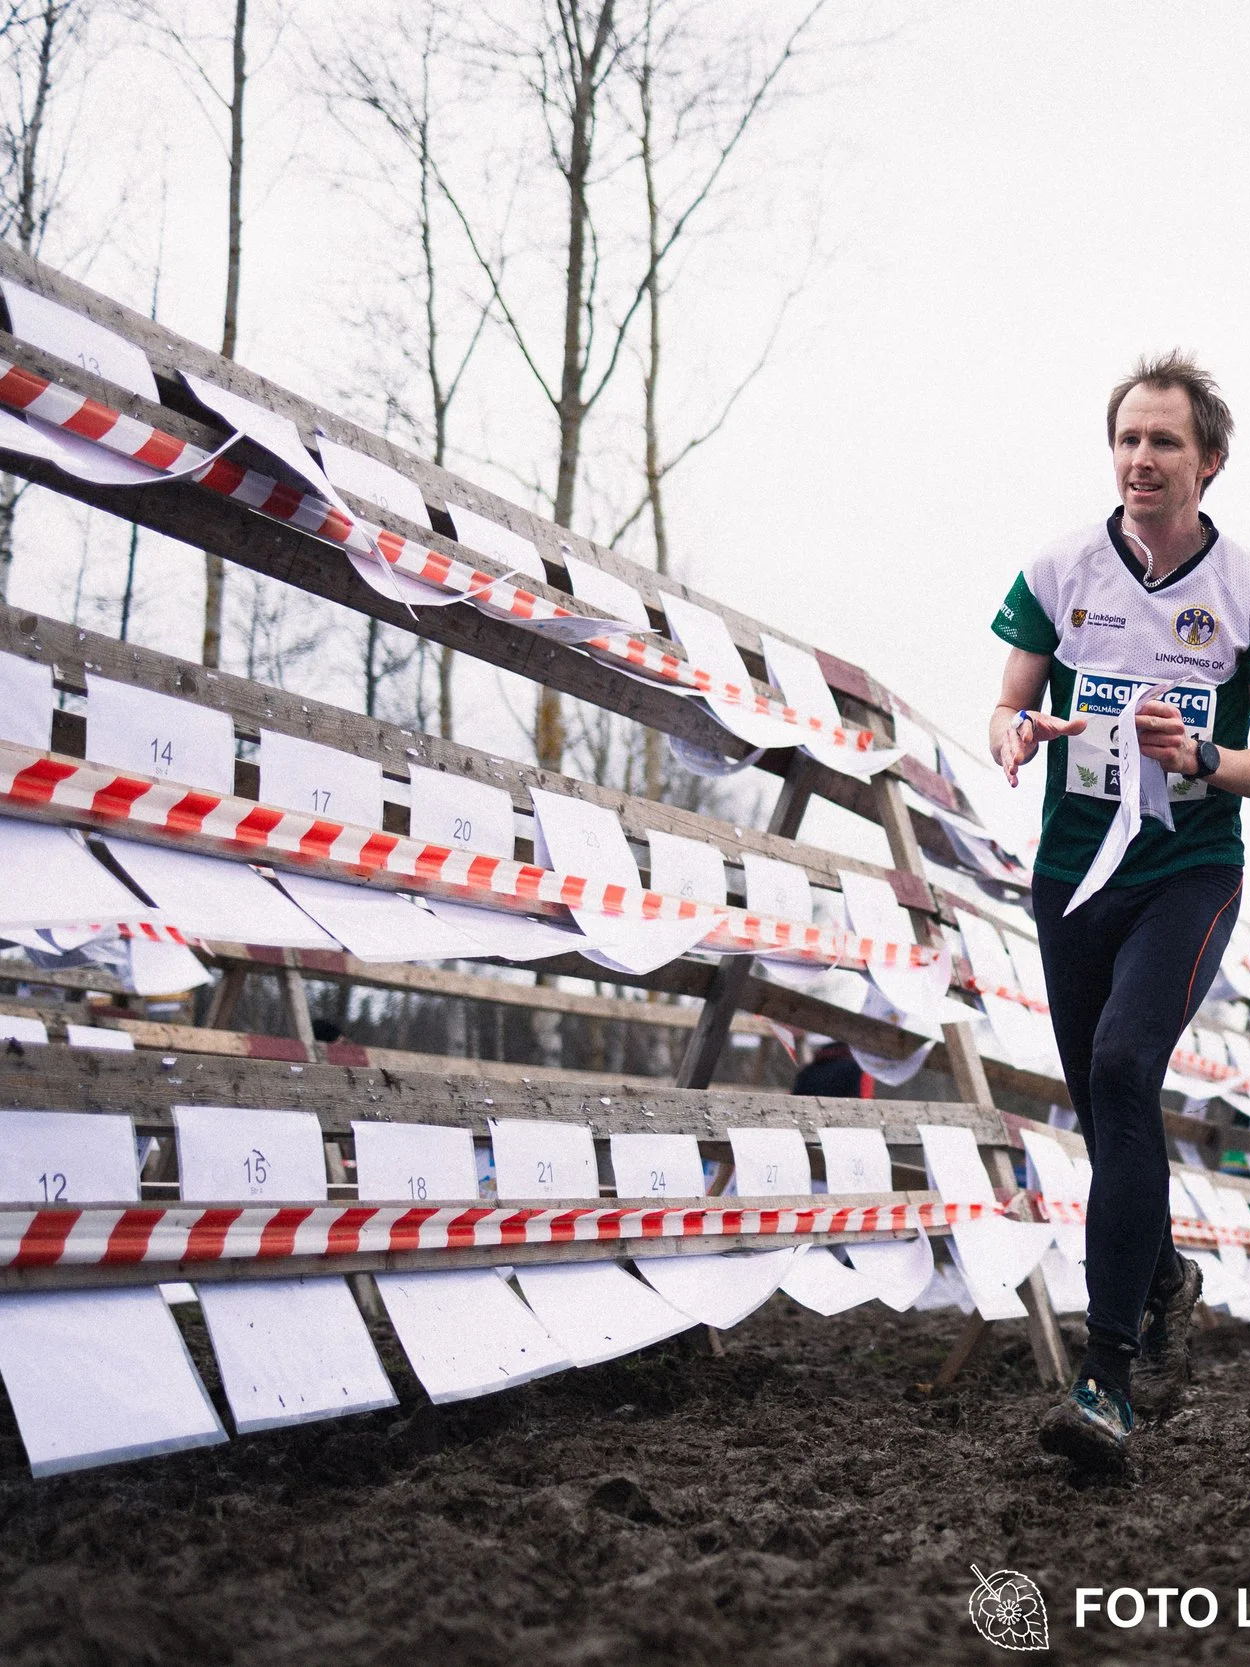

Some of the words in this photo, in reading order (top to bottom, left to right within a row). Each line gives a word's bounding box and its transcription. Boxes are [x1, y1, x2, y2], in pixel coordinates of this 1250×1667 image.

[1088, 612, 1126, 625] Linköping
[1155, 652, 1210, 668] LINKÖPINGS
[1211, 660, 1225, 670] OK
[1080, 677, 1209, 711] bagera
[150, 738, 174, 766] 14
[311, 788, 332, 813] 17
[453, 818, 472, 842] 20
[243, 1157, 267, 1184] 15
[537, 1161, 553, 1183] 21
[650, 1171, 666, 1191] 24
[765, 1164, 779, 1183] 27
[38, 1173, 68, 1202] 12
[407, 1176, 427, 1201] 18
